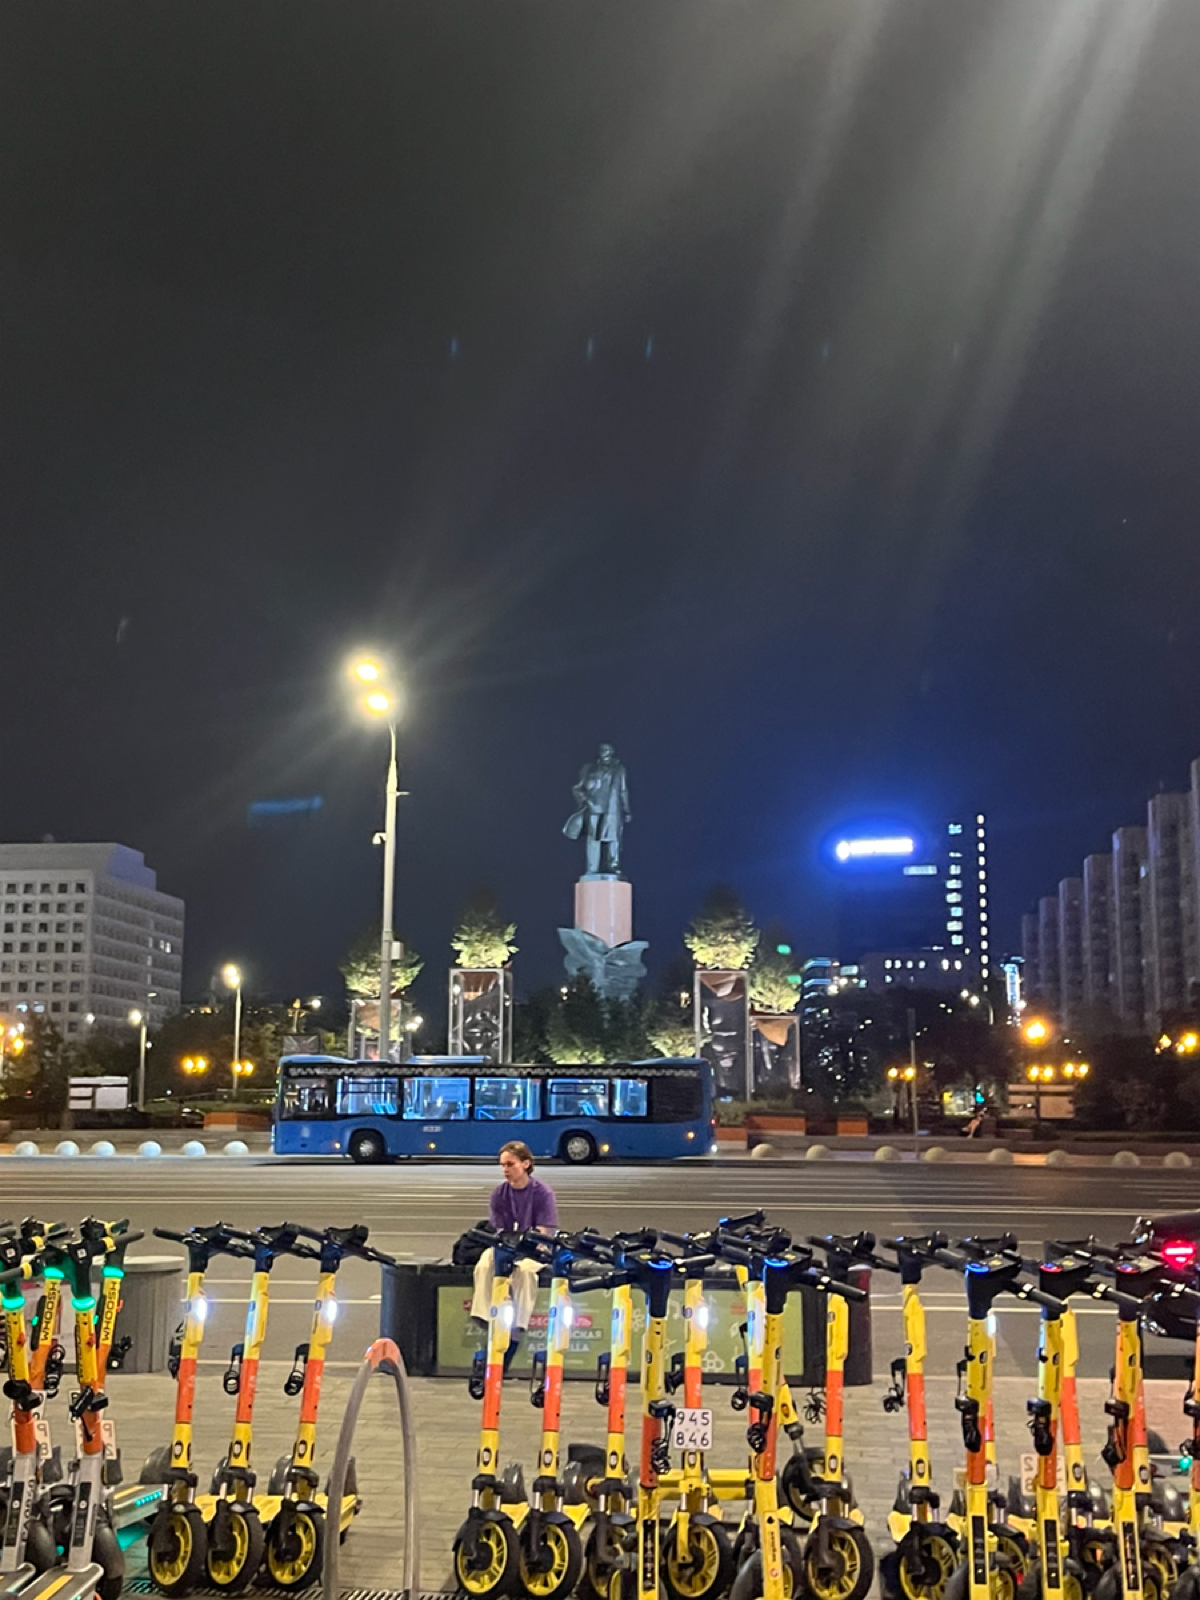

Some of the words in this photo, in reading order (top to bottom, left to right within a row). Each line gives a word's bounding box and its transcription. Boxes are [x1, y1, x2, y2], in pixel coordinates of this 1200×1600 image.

[41, 1281, 57, 1341] WHOOSH
[101, 1281, 117, 1341] WHOOSH
[676, 1411, 710, 1426] 945
[676, 1431, 710, 1447] 846
